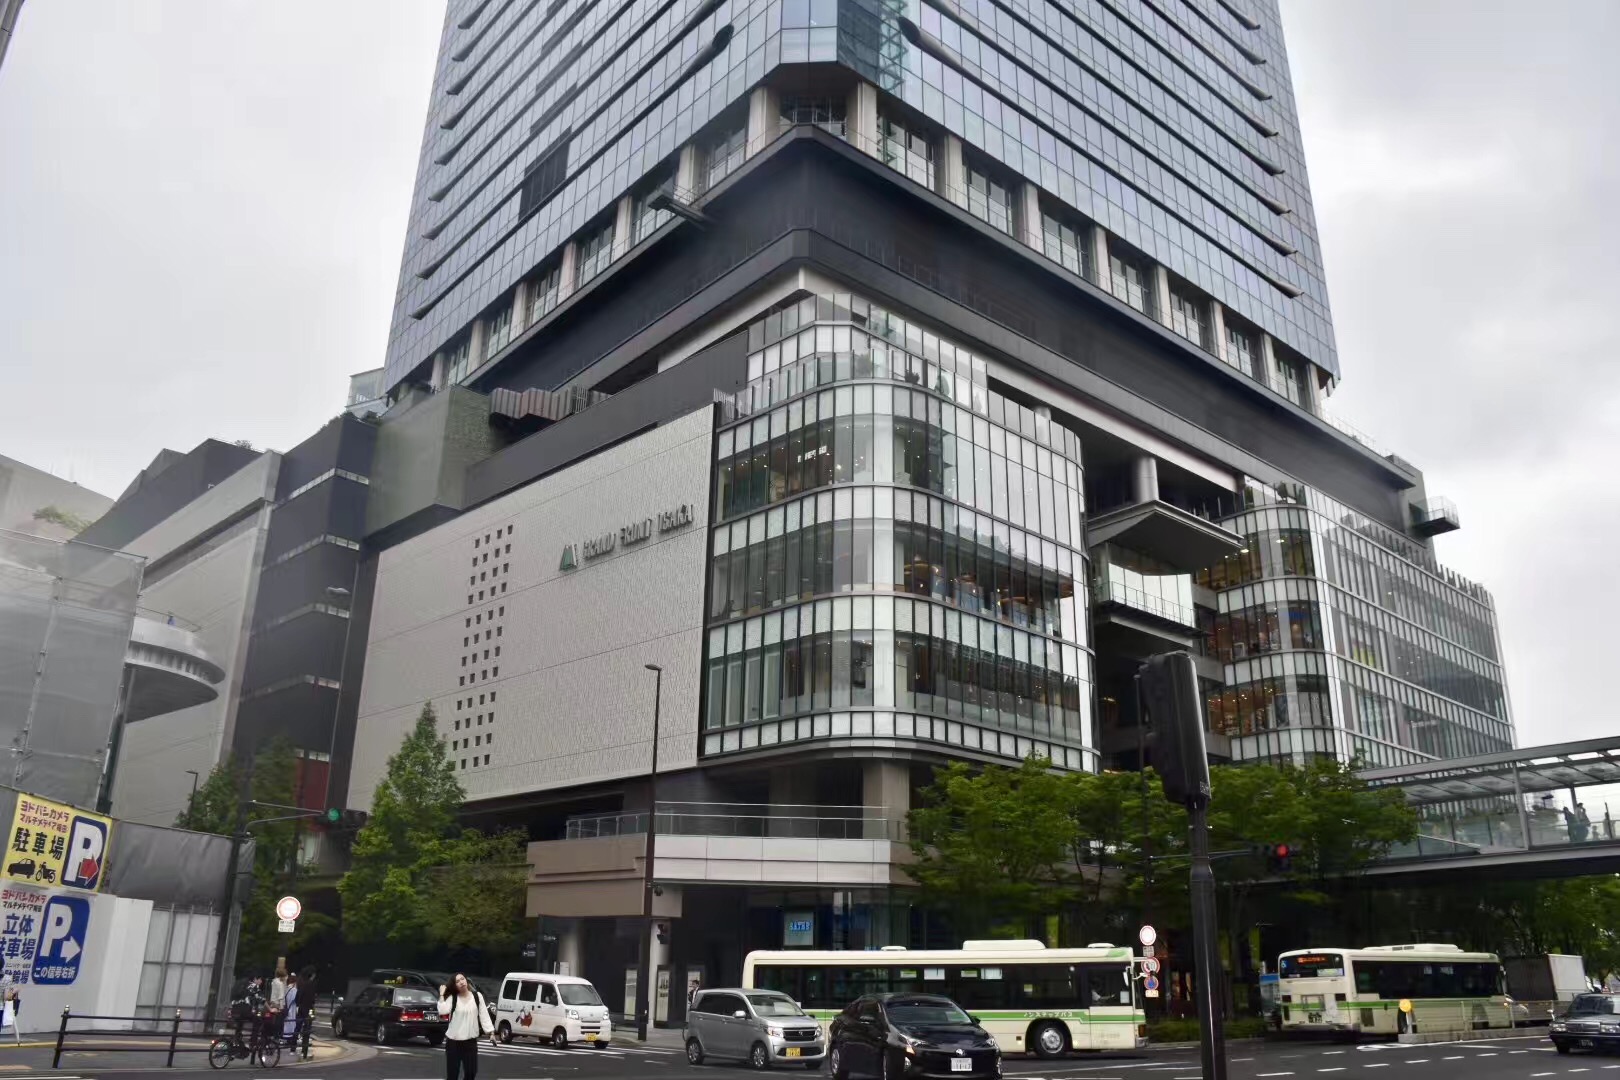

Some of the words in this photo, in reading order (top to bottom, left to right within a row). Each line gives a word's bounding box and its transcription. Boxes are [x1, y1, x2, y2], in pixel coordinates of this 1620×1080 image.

[20, 800, 70, 822] ヨドバシカメラ
[12, 827, 65, 860] 駐車場
[64, 821, 103, 882] P
[1, 889, 47, 904] ヨドバシカメラ
[2, 913, 34, 936] 立体
[40, 903, 73, 957] P
